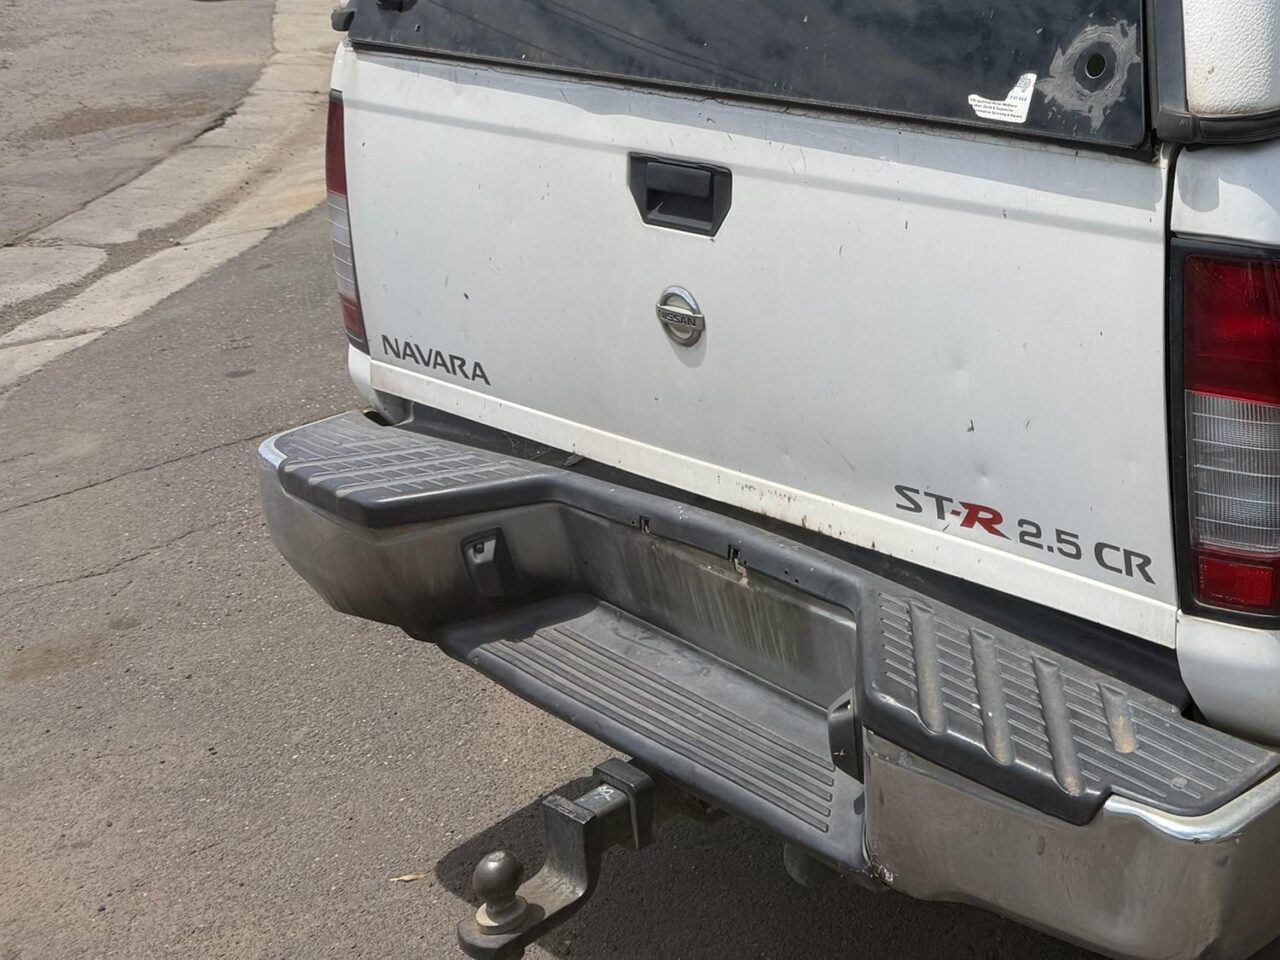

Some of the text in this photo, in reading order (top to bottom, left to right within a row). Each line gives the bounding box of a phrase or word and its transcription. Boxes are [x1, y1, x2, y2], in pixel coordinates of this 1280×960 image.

[381, 334, 491, 386] NAVARA
[1017, 518, 1082, 560] 2.5
[1094, 541, 1156, 585] CR
